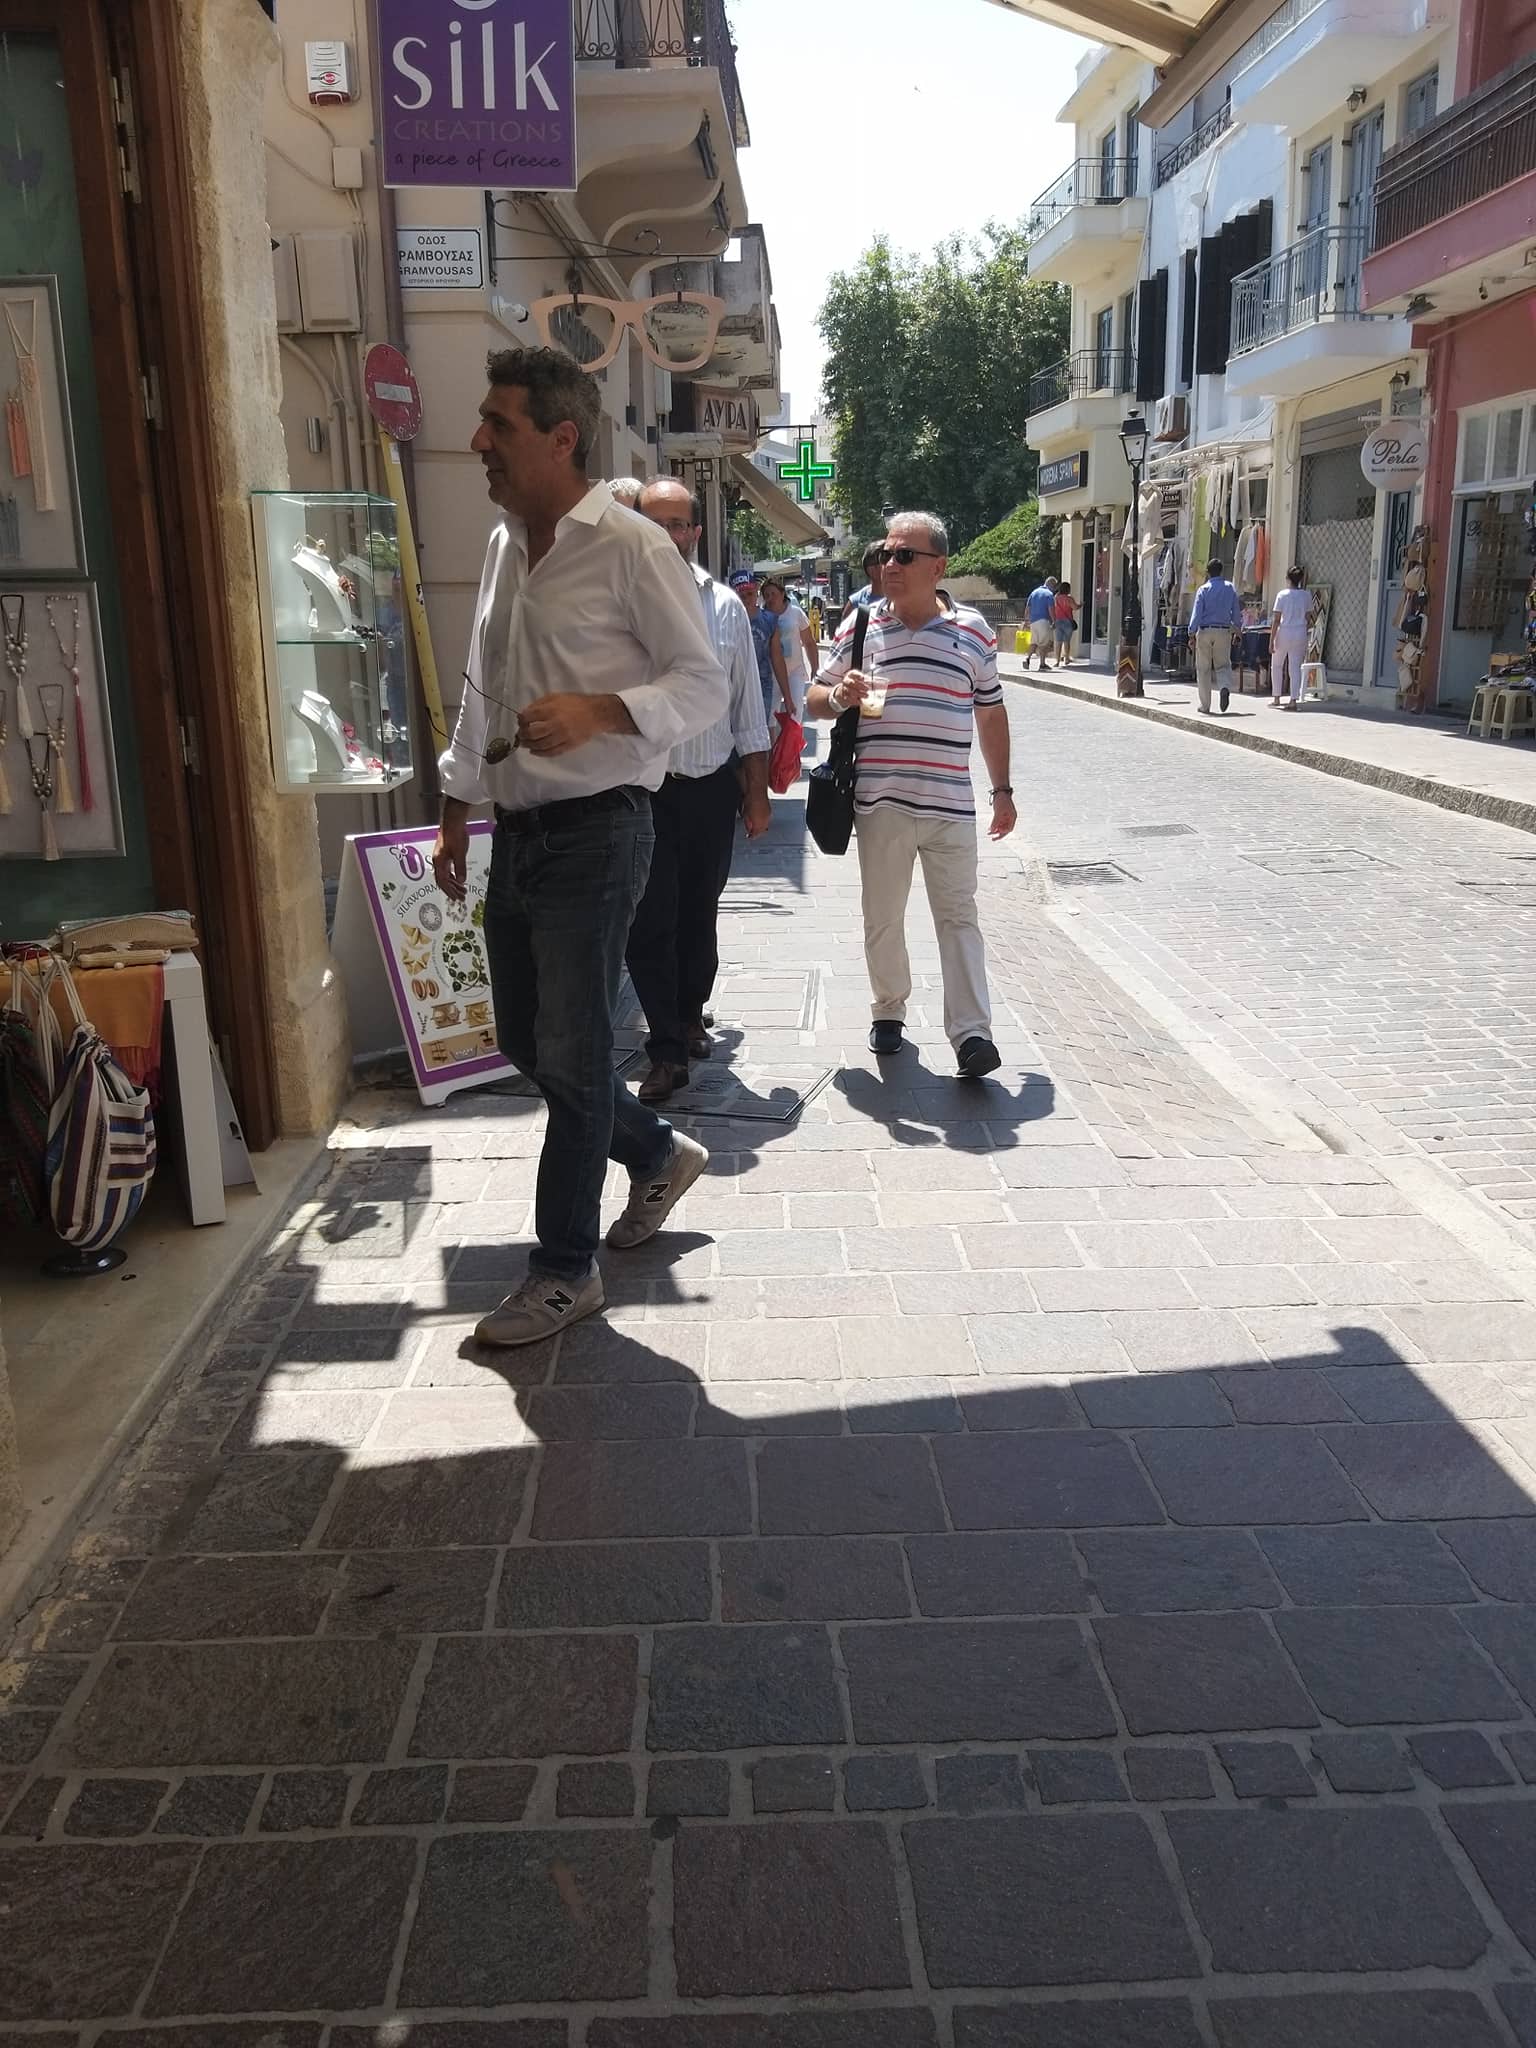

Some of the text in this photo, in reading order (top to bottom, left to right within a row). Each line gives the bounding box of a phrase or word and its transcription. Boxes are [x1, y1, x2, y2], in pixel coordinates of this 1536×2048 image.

[392, 20, 560, 111] silk
[394, 118, 561, 144] CREATIONS
[394, 148, 562, 176] a piece of Greece
[417, 236, 447, 245] ΟΔΟΣ
[398, 250, 474, 262] ΡΑΜΒΟΥΣΑΣ
[704, 399, 747, 430] ΑΥΡΑ
[1372, 438, 1421, 465] Perla
